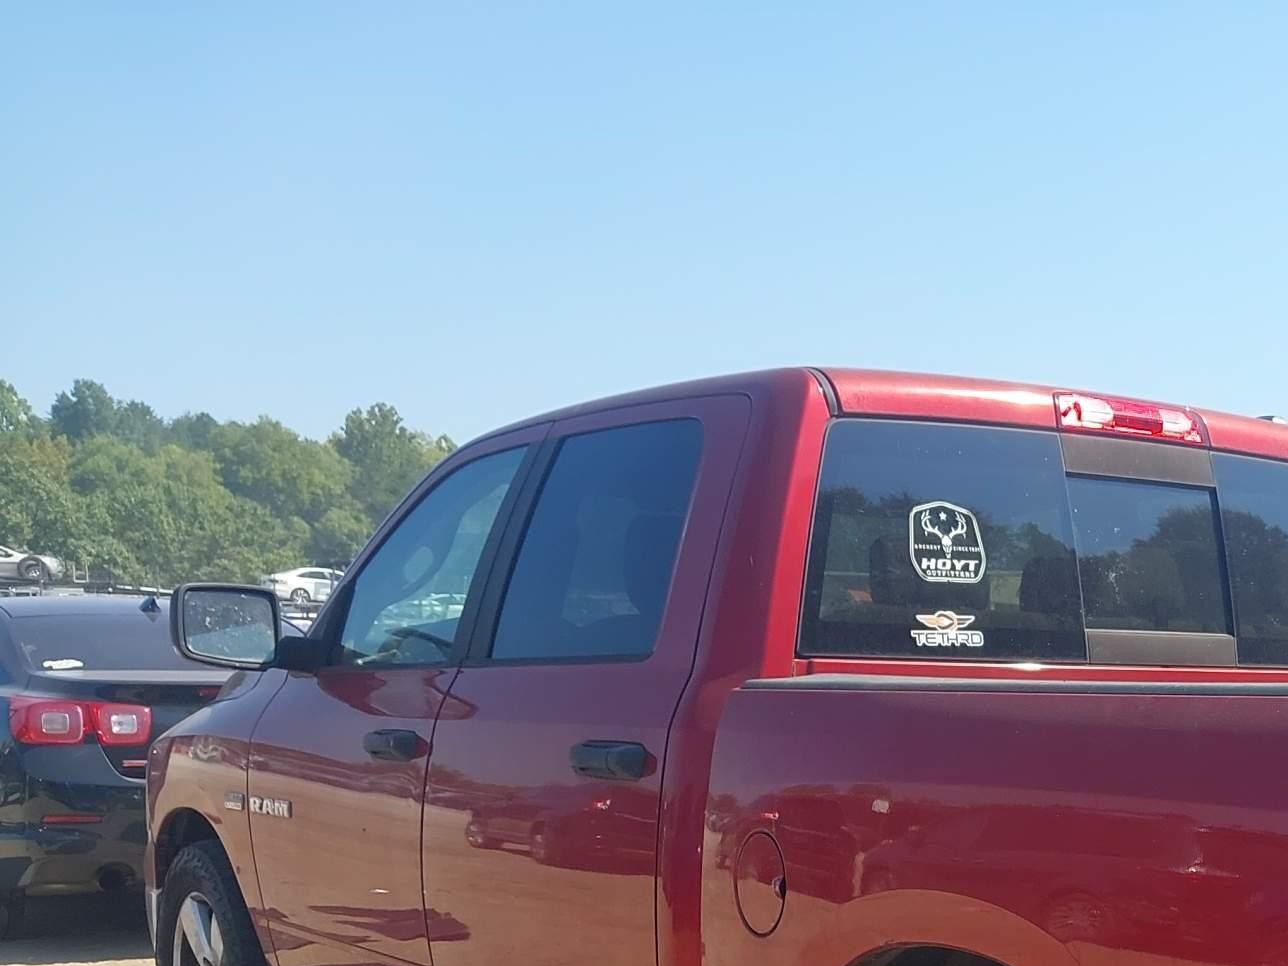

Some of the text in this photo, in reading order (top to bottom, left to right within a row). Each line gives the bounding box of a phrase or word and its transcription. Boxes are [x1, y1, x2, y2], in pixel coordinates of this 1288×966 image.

[921, 557, 979, 571] HOYT
[926, 570, 975, 578] OUTFITTERS
[911, 630, 984, 646] TETHRD
[249, 796, 290, 818] RAM
